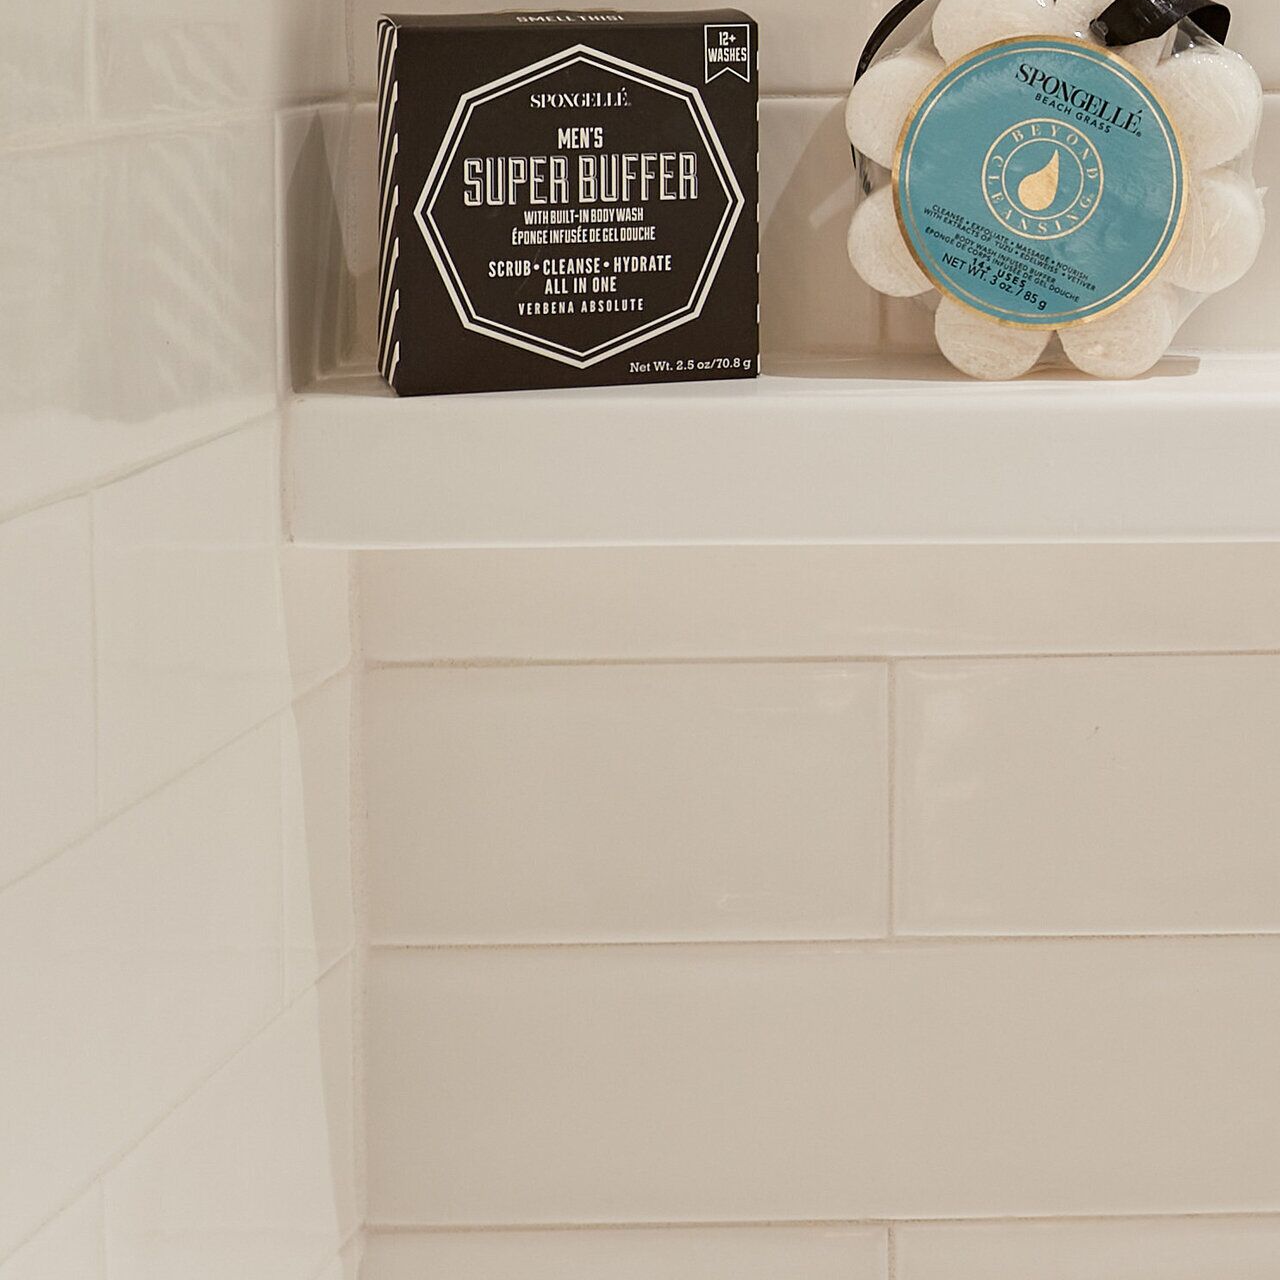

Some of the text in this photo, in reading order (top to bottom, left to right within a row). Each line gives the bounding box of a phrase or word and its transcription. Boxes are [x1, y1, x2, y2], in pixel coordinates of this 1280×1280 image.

[718, 31, 737, 46] 12+
[707, 47, 747, 62] WASHES
[530, 87, 629, 108] SPONGELLÉ
[1034, 92, 1112, 134] BEACH GRASS
[558, 127, 603, 149] MEN'S
[1011, 124, 1098, 179] BEYOND
[464, 152, 698, 206] SUPER BUFFER
[988, 155, 1092, 233] CLEANSING
[524, 207, 644, 225] WITH BUILT-IN BODY WASH
[512, 225, 656, 246] ÉPONGE INFUSÉE DE GEL DOUCHE
[932, 204, 1089, 280] CLEANSE EXFOLIATE MASSAGE NOURISH
[924, 207, 943, 220] WITH
[943, 217, 980, 238] EXTRACTS
[1020, 252, 1059, 274] EDELWEISS
[1067, 274, 1096, 292] VETIVER
[955, 233, 976, 247] BODY
[976, 243, 997, 256] WASH
[1030, 268, 1056, 283] BUFFER
[488, 255, 672, 278] SCRUB CLEANSE HYDRATE
[956, 242, 967, 251] DE
[967, 247, 991, 261] CORPS
[1023, 272, 1033, 280] DE
[1034, 277, 1048, 288] GEL
[1049, 284, 1080, 303] DOUCHE
[973, 258, 1027, 288] 14+ USES
[544, 276, 617, 295] ALL IN ONE
[942, 252, 967, 270] NET
[968, 264, 987, 281] WT.
[989, 275, 999, 285] 3
[1023, 291, 1039, 304] 85
[1037, 301, 1047, 311] g
[518, 298, 644, 316] VERBENA ABSOLUTE
[629, 357, 751, 373] Net Wt. 2.5 oz/70.8 g
